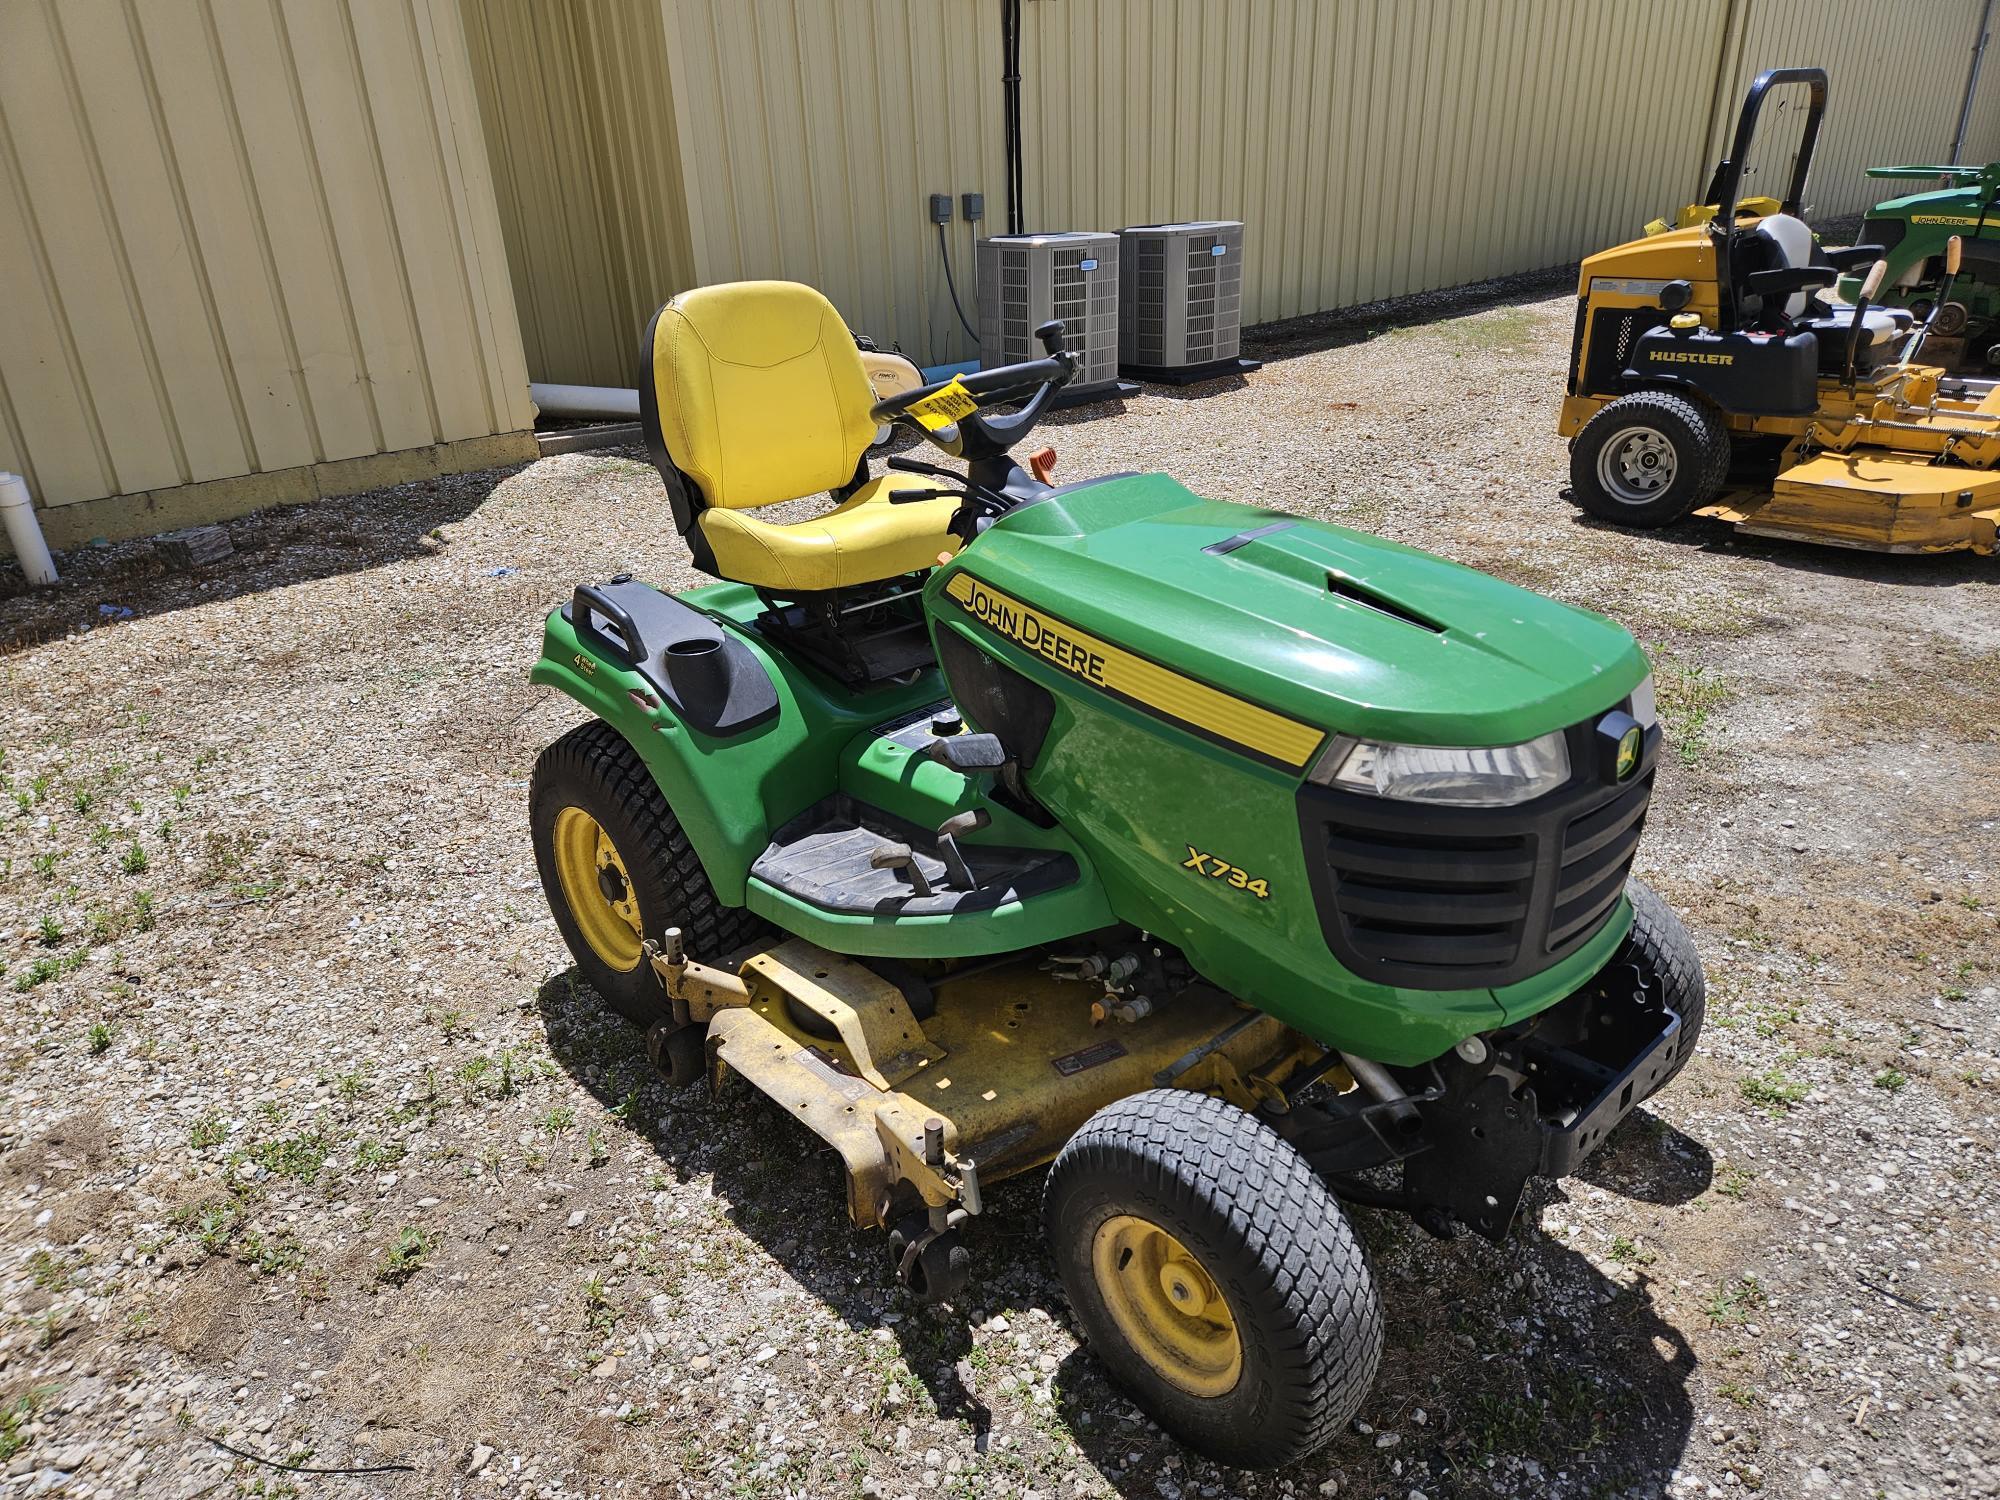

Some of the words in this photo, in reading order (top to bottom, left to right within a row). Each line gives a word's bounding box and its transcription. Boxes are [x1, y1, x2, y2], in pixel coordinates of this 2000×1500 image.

[1916, 216, 1938, 225] JOHN
[1939, 216, 1968, 226] DEERE
[1649, 350, 1734, 366] HUSTLER
[963, 582, 1018, 637] JOHN
[1023, 613, 1106, 683] DEERE
[574, 654, 581, 667] 4
[1182, 845, 1270, 899] X734
